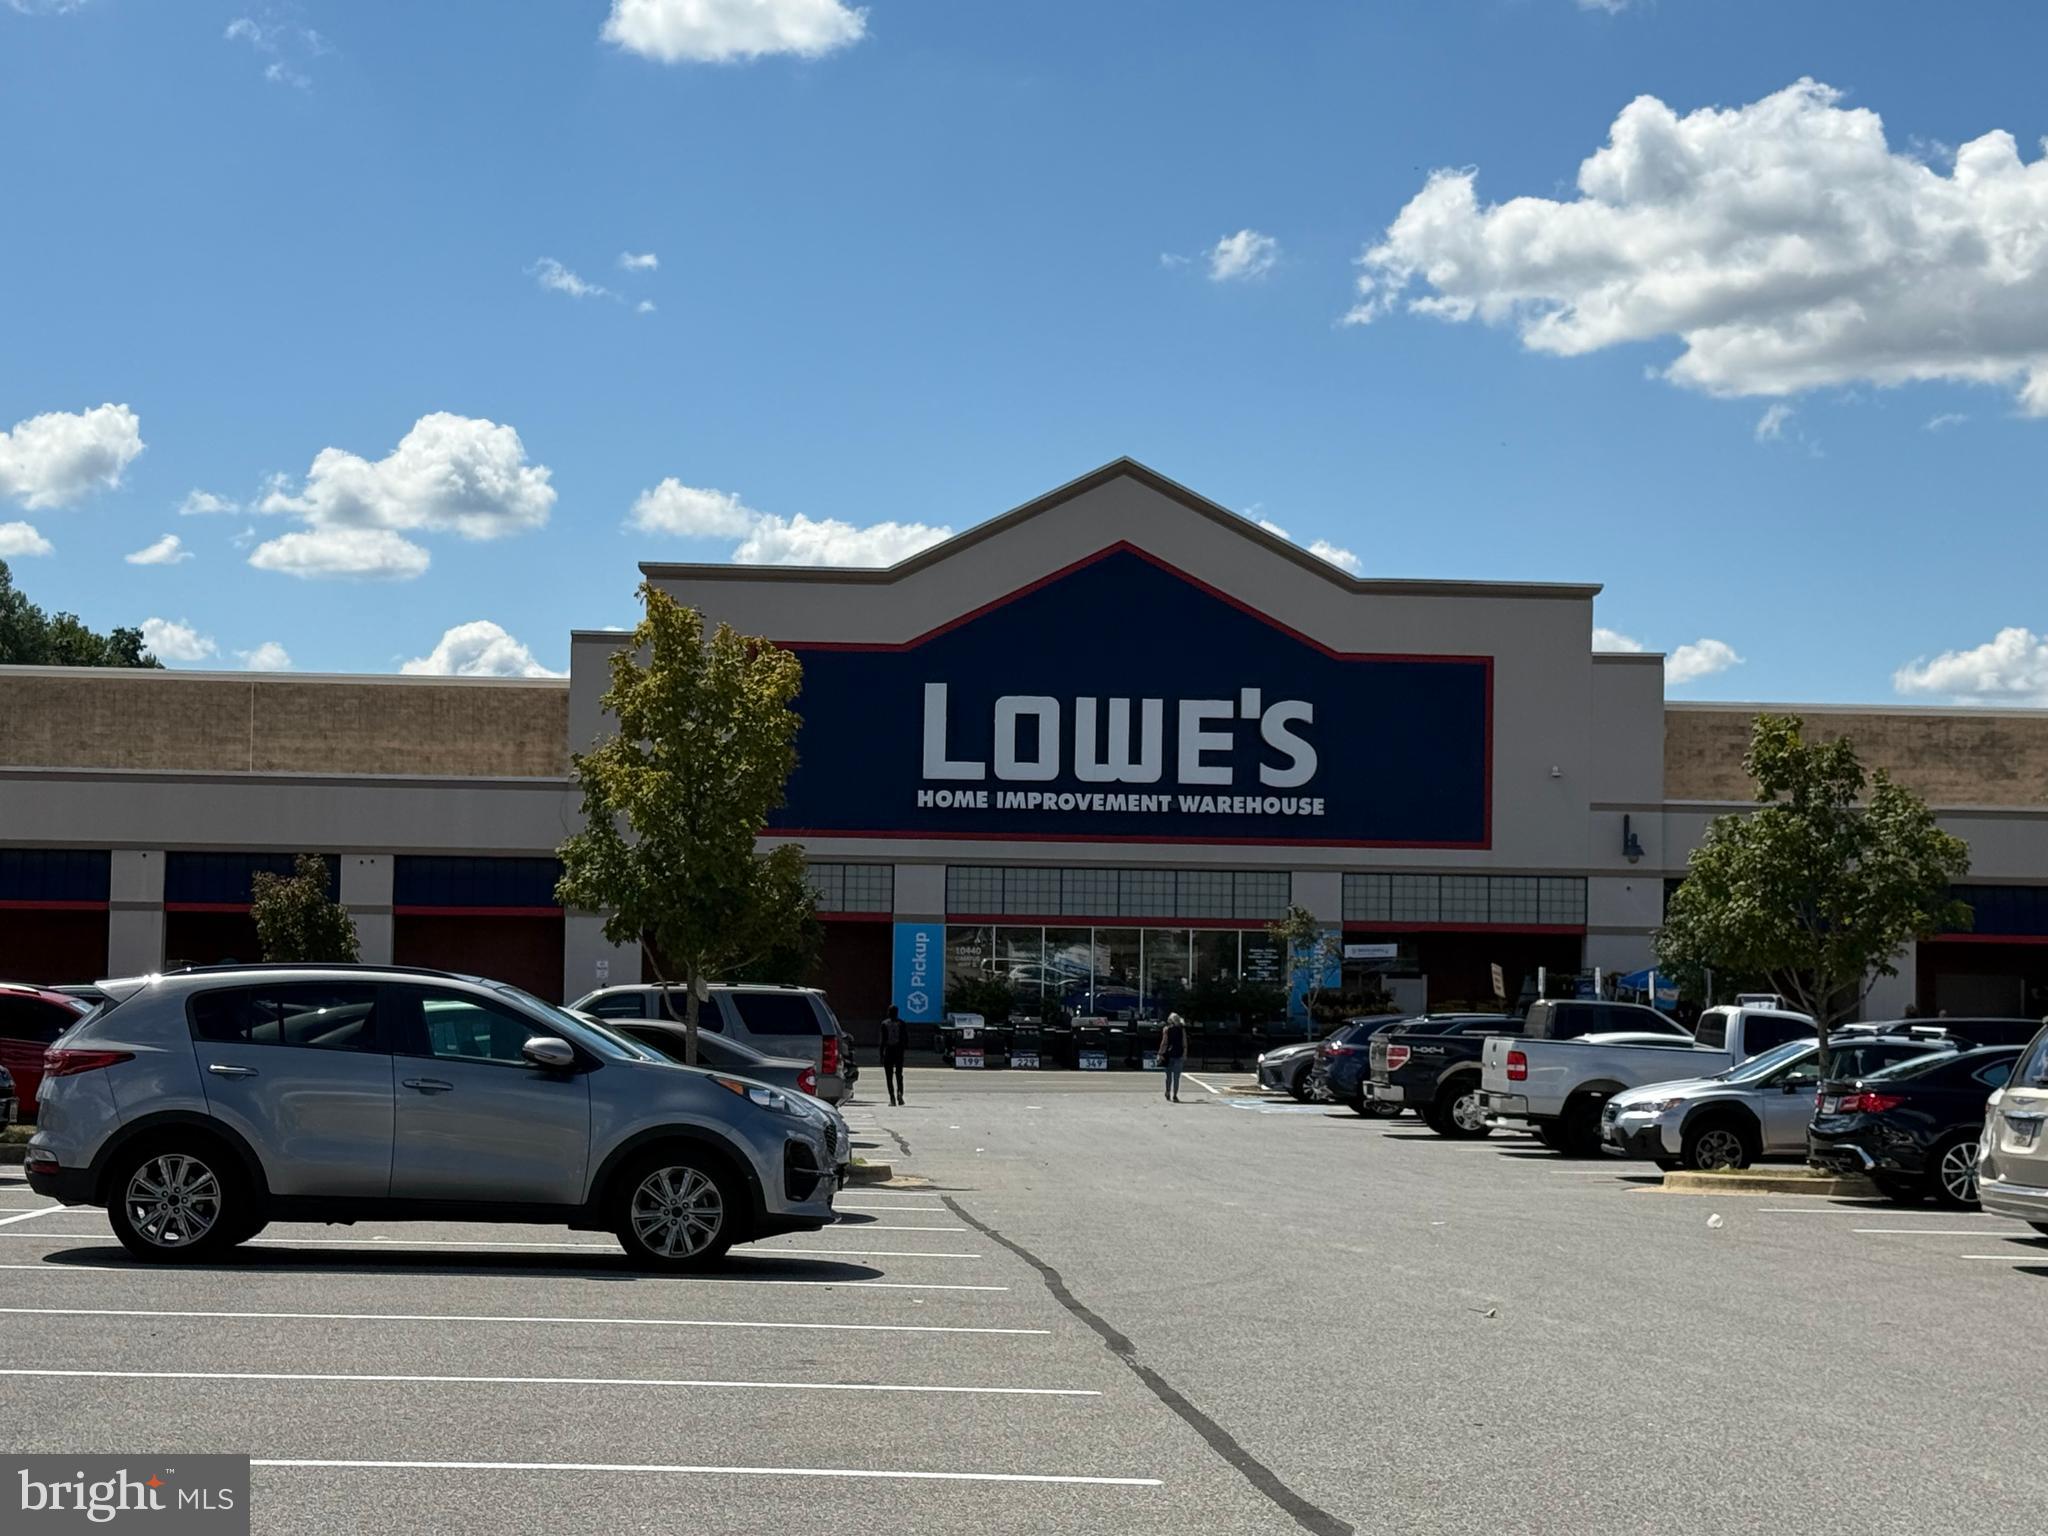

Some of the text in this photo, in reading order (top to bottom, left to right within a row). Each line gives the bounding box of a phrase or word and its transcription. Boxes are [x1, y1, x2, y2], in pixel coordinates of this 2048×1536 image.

[923, 682, 1318, 788] LOWE'S
[917, 790, 1325, 816] HOME IMPROVEMENT WAREHOUSE
[911, 932, 930, 987] Pickup
